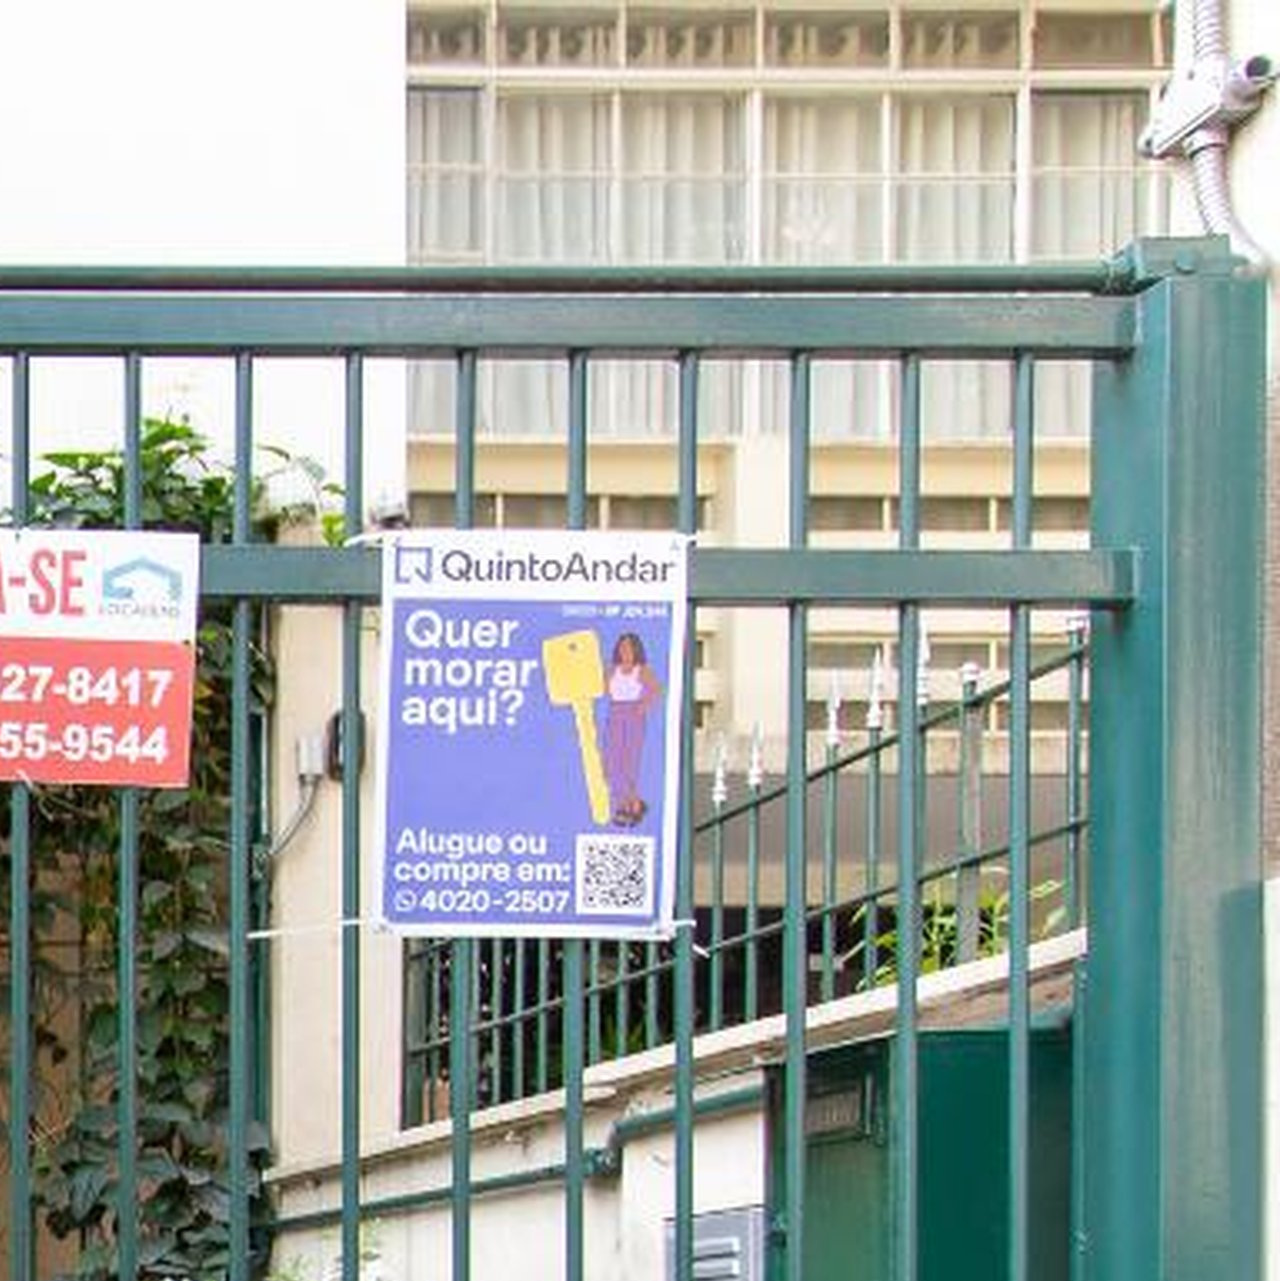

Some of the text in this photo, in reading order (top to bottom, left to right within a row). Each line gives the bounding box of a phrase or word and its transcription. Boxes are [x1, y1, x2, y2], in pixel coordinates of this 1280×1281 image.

[441, 550, 677, 582] QuintoAndar
[404, 609, 519, 648] Quer
[403, 658, 538, 688] morar
[401, 689, 525, 735] aqui?
[395, 828, 547, 859] Alugue ou
[394, 861, 571, 888] compre em:
[420, 892, 570, 913] 4020-2507
